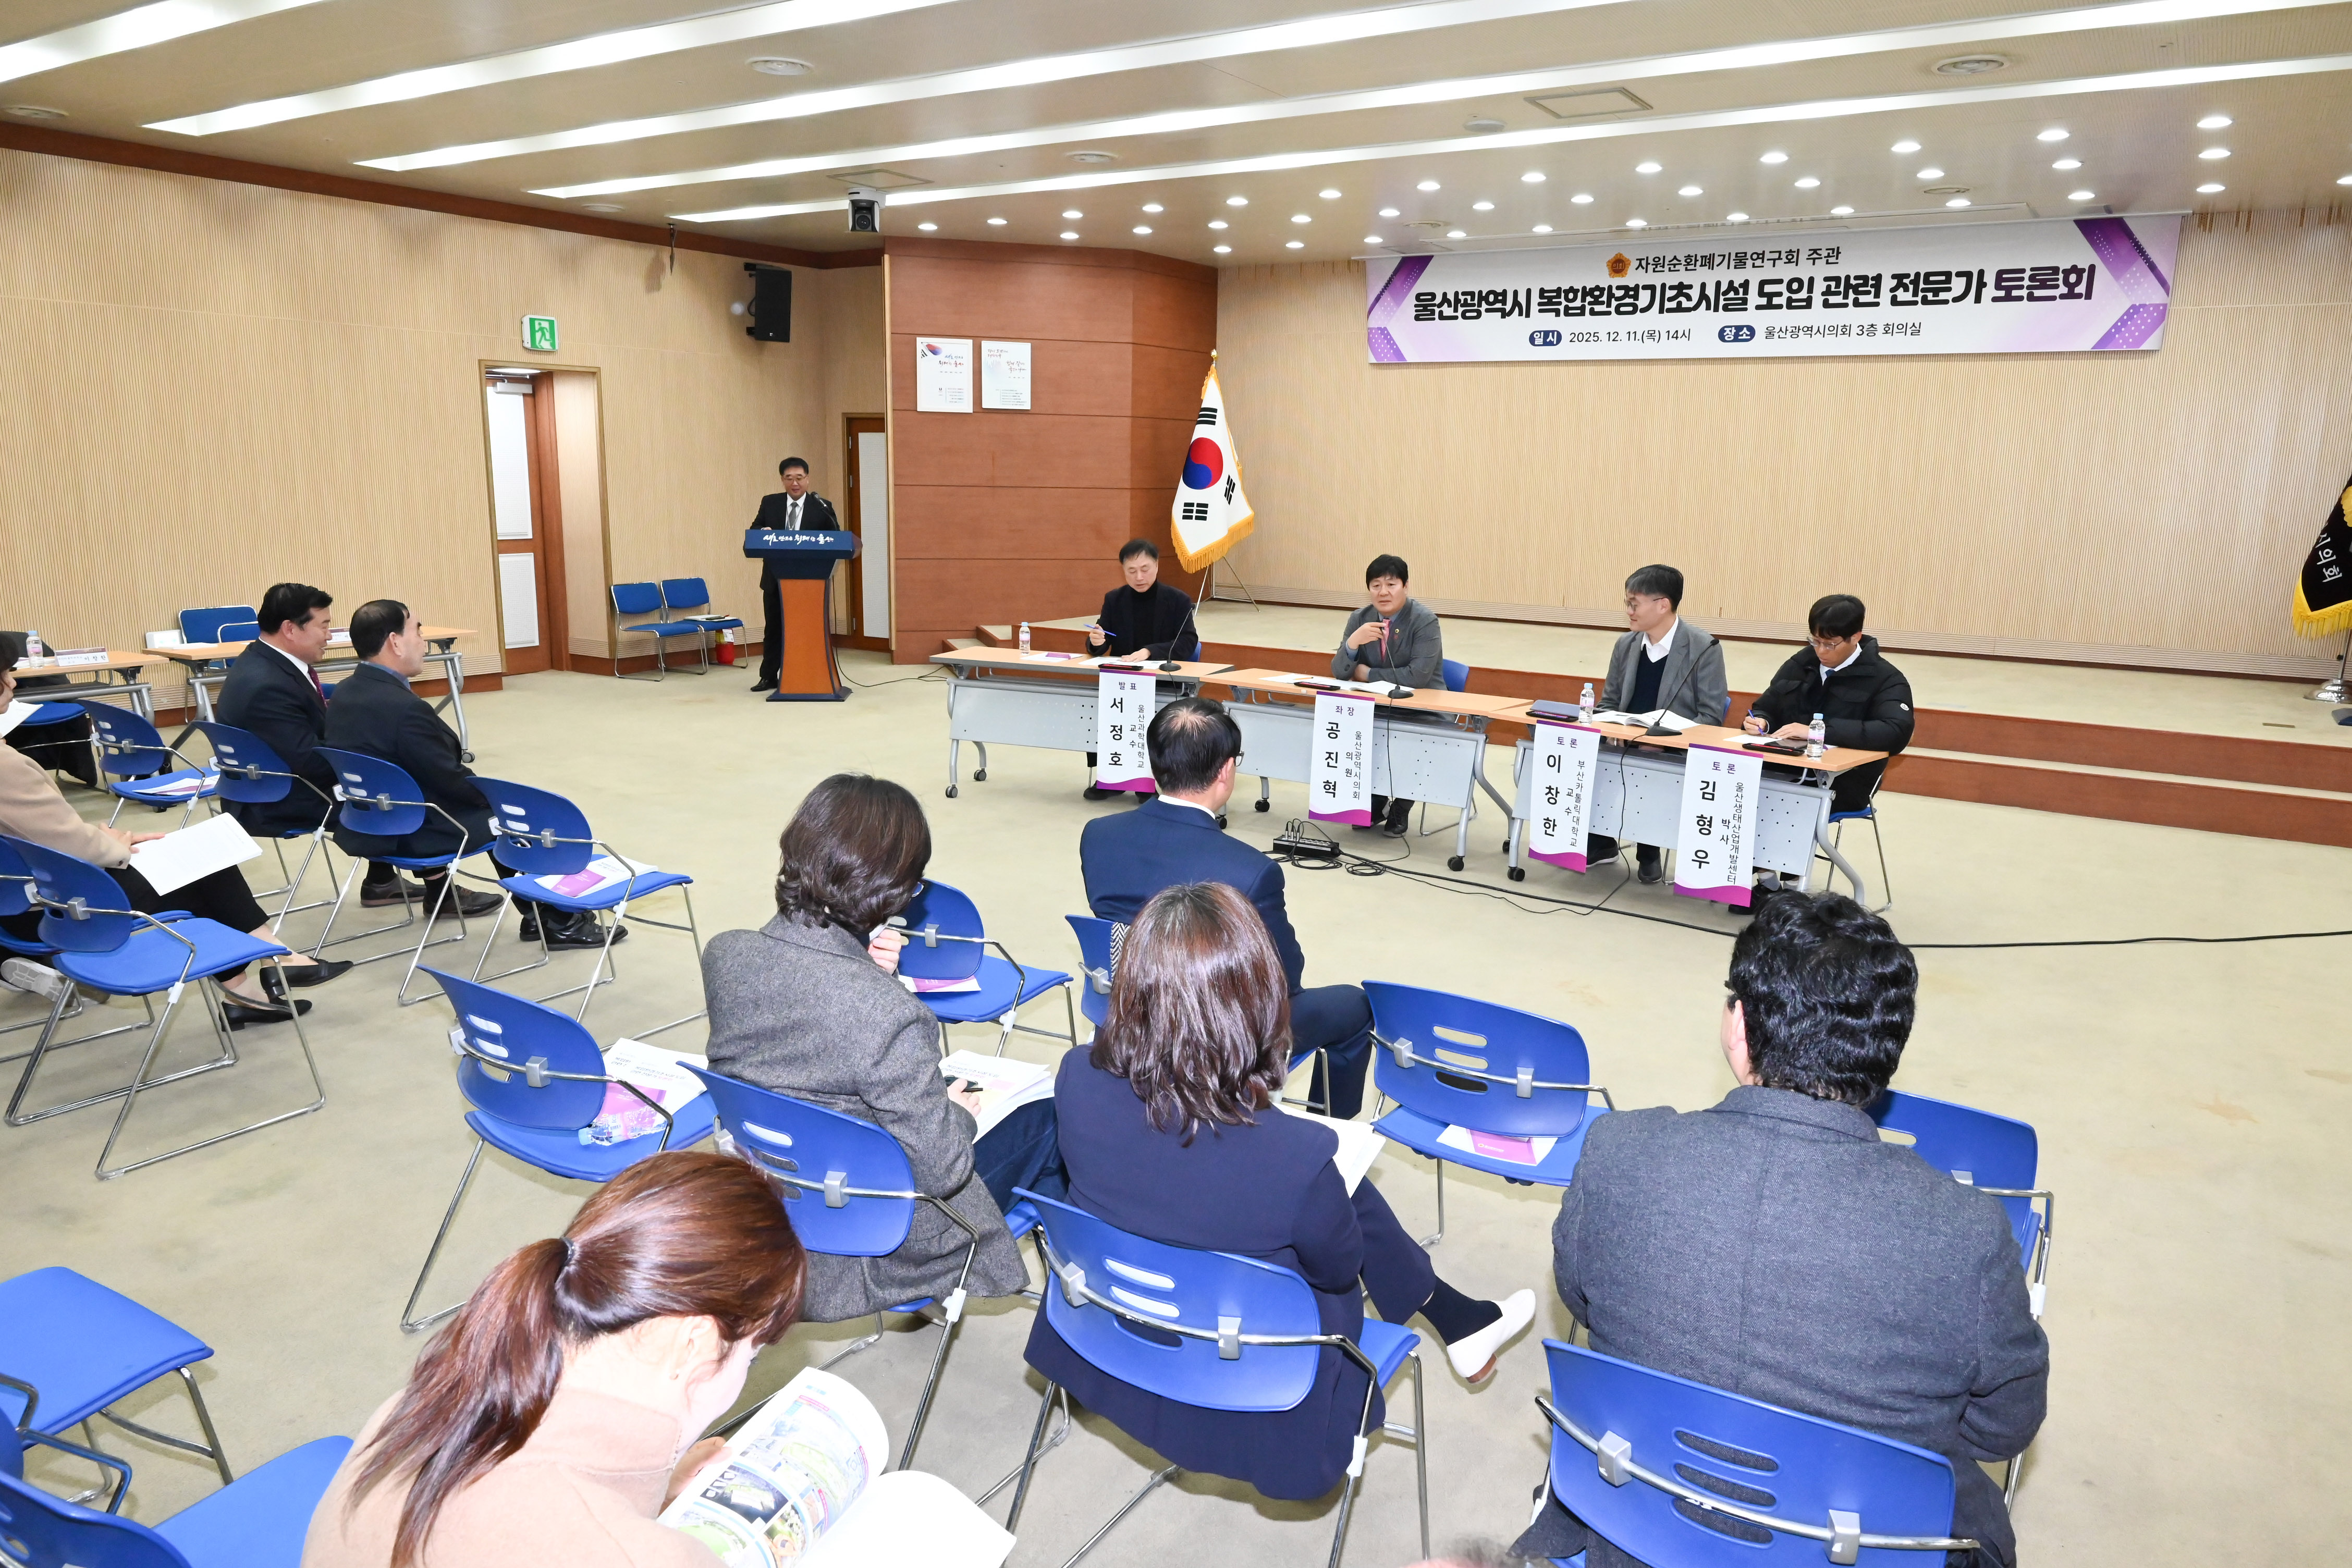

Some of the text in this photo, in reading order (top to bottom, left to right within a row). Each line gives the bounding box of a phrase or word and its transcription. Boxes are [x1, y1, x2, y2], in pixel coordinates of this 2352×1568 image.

[1414, 263, 2096, 322] 울산광역시 복합환경기초시설 도입 관련 전문가 토론회
[1635, 247, 1842, 273] 자원순환폐기물연구회 주관
[1570, 332, 1602, 342] 2025.
[1607, 332, 1622, 342] 12.
[1627, 330, 1661, 344] 11.(목)
[1666, 328, 1690, 341] 14시
[1765, 324, 1852, 339] 울산광역시의회
[1856, 324, 1878, 337] 3층
[1882, 322, 1921, 337] 회의실
[2315, 522, 2342, 582] 시의회
[1108, 697, 1123, 766] 서정호
[1323, 721, 1340, 798] 공진혁
[1352, 731, 1362, 800] 울산광역시의회
[1544, 754, 1561, 837] 이창한
[1569, 760, 1585, 847] 부산카톨릭대학교
[1692, 780, 1716, 869] 김형우
[1727, 782, 1744, 885] 울산생태산업개발센터
